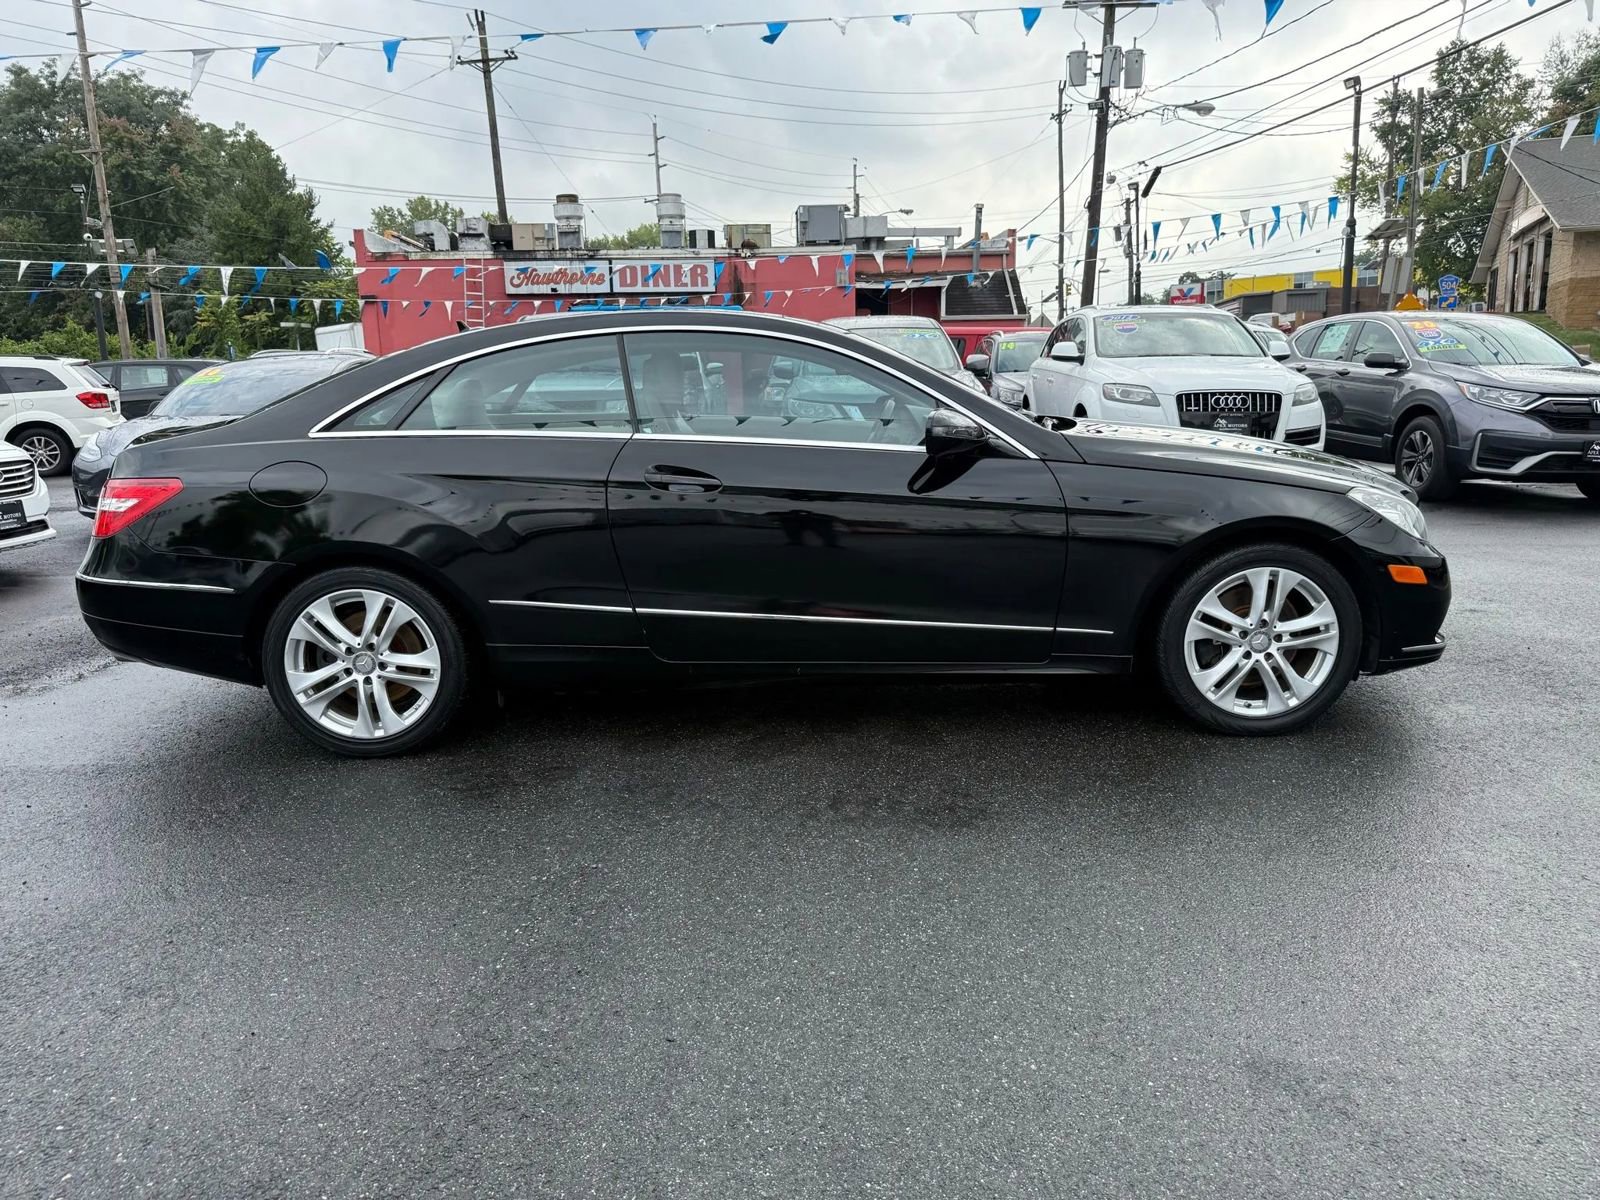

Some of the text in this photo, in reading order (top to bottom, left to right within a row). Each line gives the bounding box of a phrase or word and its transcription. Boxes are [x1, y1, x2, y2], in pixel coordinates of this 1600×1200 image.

[509, 264, 709, 289] Hawthorne DINER
[1442, 281, 1457, 290] 504
